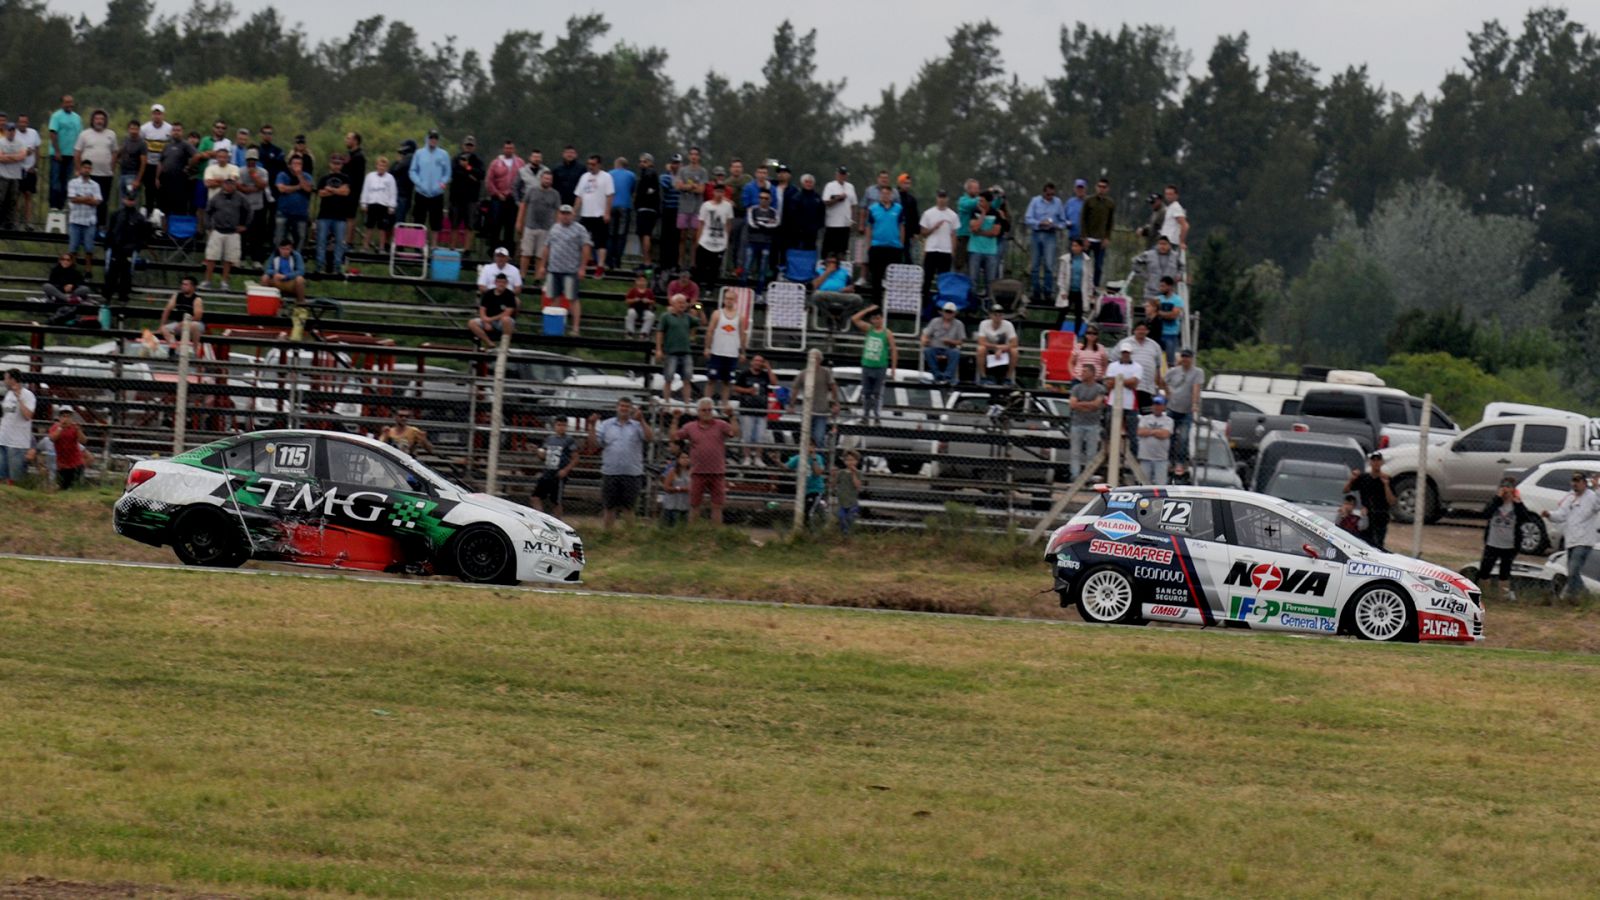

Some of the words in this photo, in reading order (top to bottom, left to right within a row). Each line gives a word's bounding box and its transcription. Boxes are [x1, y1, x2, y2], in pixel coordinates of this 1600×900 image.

[279, 446, 307, 466] 115
[256, 477, 389, 521] TMG
[1161, 501, 1191, 524] 12
[1097, 520, 1137, 532] PALADINI
[1089, 539, 1174, 565] SISTEMAFREE
[1223, 561, 1331, 597] NOVA
[1349, 562, 1401, 579] CAMURRI
[1155, 587, 1188, 596] SANCOR
[1155, 594, 1188, 602] SEGUROS
[1150, 605, 1181, 617] OMBU
[1281, 613, 1318, 629] General
[1320, 617, 1336, 631] Paz
